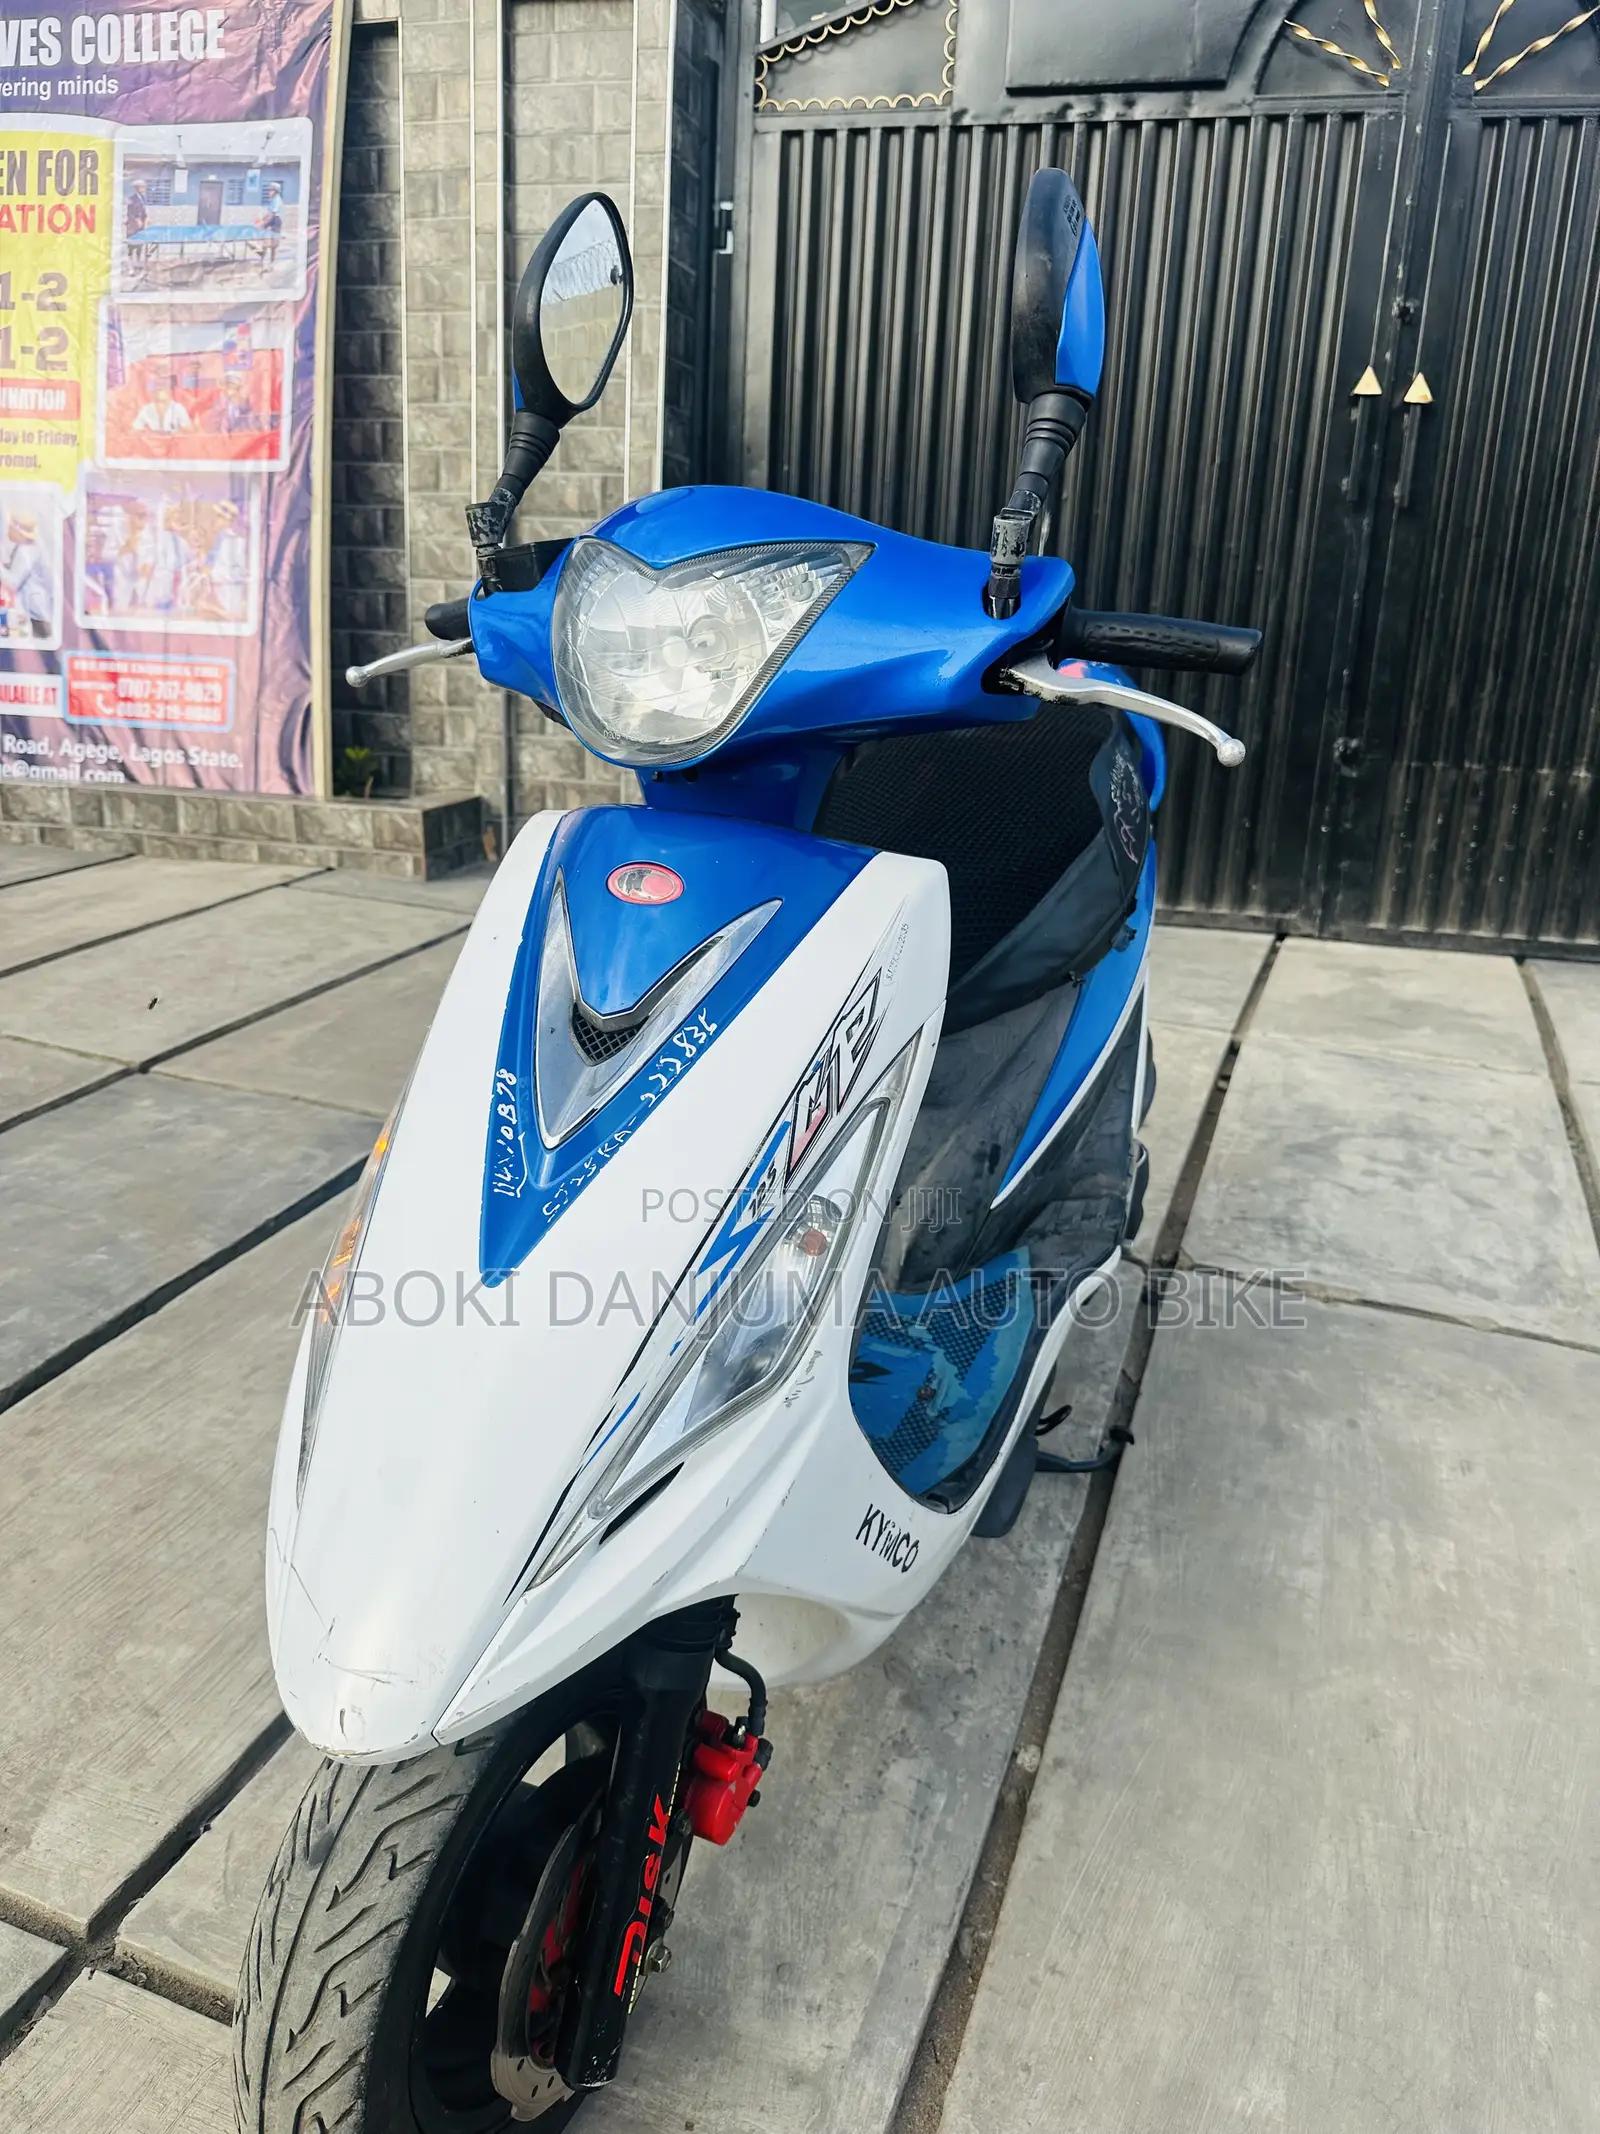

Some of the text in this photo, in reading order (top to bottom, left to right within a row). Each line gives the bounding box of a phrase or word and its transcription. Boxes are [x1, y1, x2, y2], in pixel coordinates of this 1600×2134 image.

[0, 10, 226, 67] VES COLLEGE
[57, 75, 119, 96] minds
[37, 149, 99, 196] FOR
[0, 204, 96, 234] ATION
[0, 271, 68, 312] 1-2
[0, 326, 68, 371] 1-2
[3, 733, 243, 769] Road, Agege, Lagos State.
